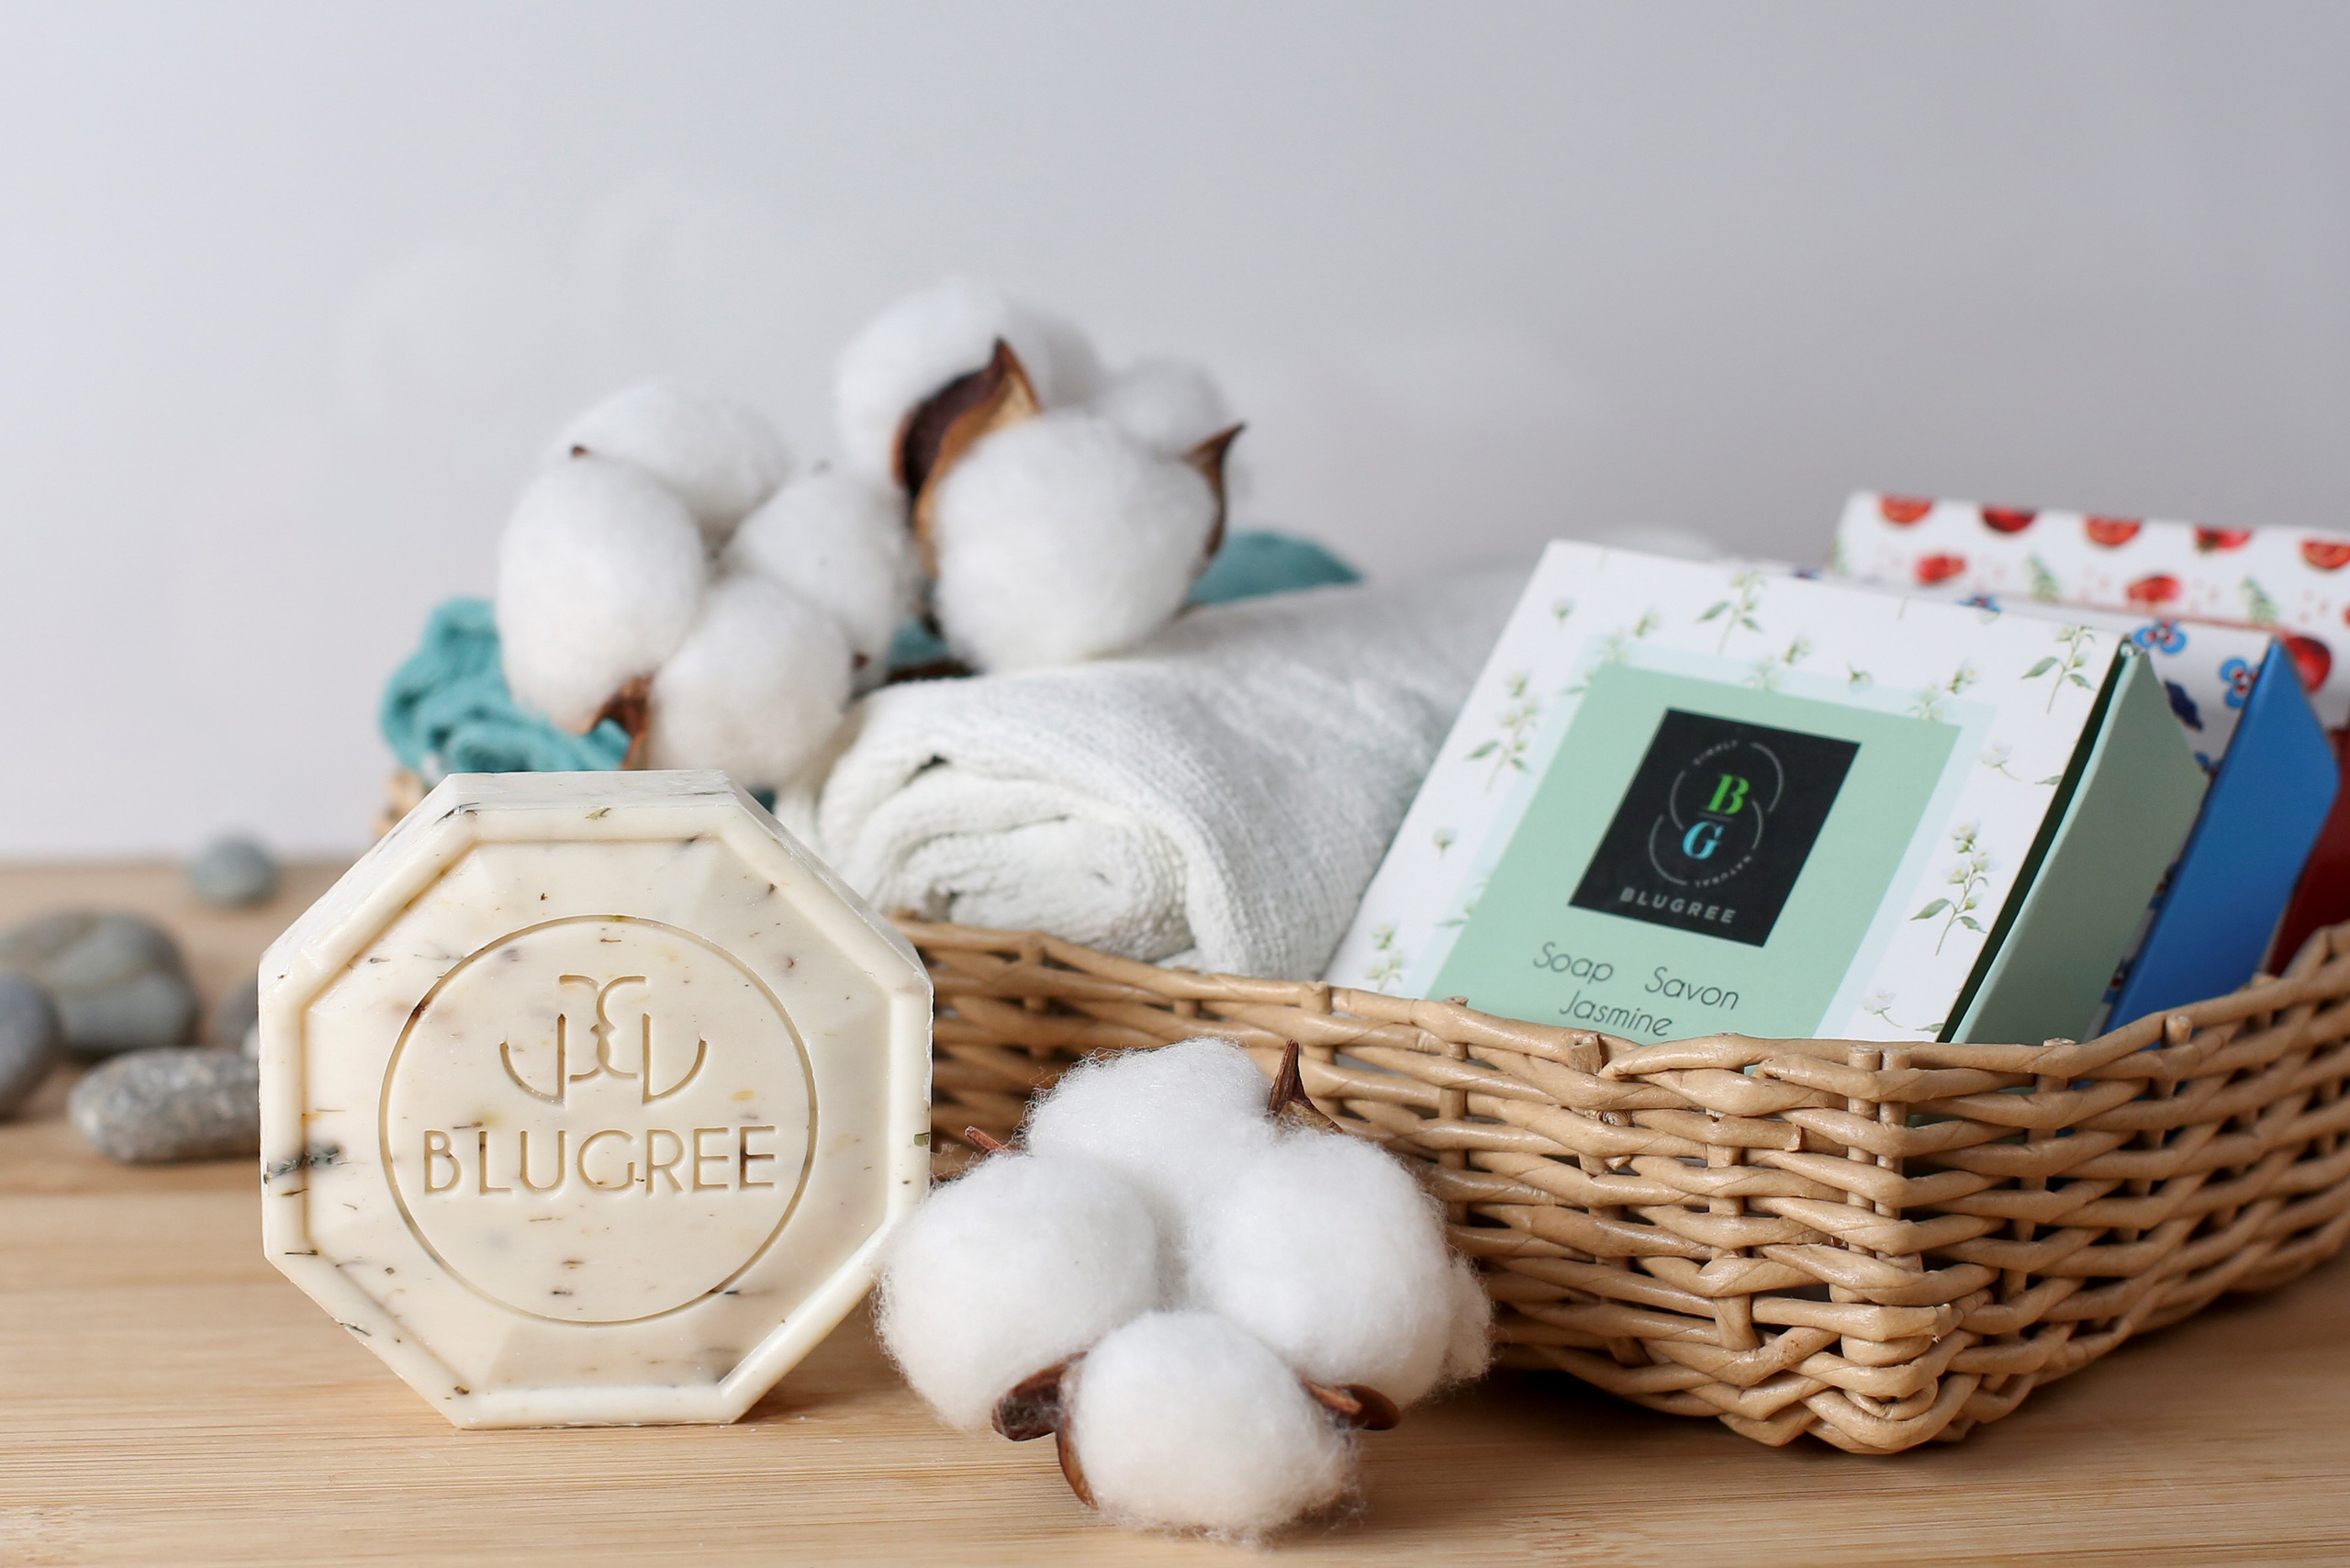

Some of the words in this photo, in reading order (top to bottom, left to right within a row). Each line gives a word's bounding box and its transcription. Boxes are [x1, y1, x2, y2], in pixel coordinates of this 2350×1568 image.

[1707, 774, 1749, 814] B
[1682, 821, 1724, 859] G
[1619, 887, 1736, 924] BLUGREE
[1533, 941, 1614, 983] Soap
[1644, 966, 1740, 1010] Savon
[1559, 990, 1673, 1036] Jasmine
[423, 1126, 776, 1196] BLUGREE
